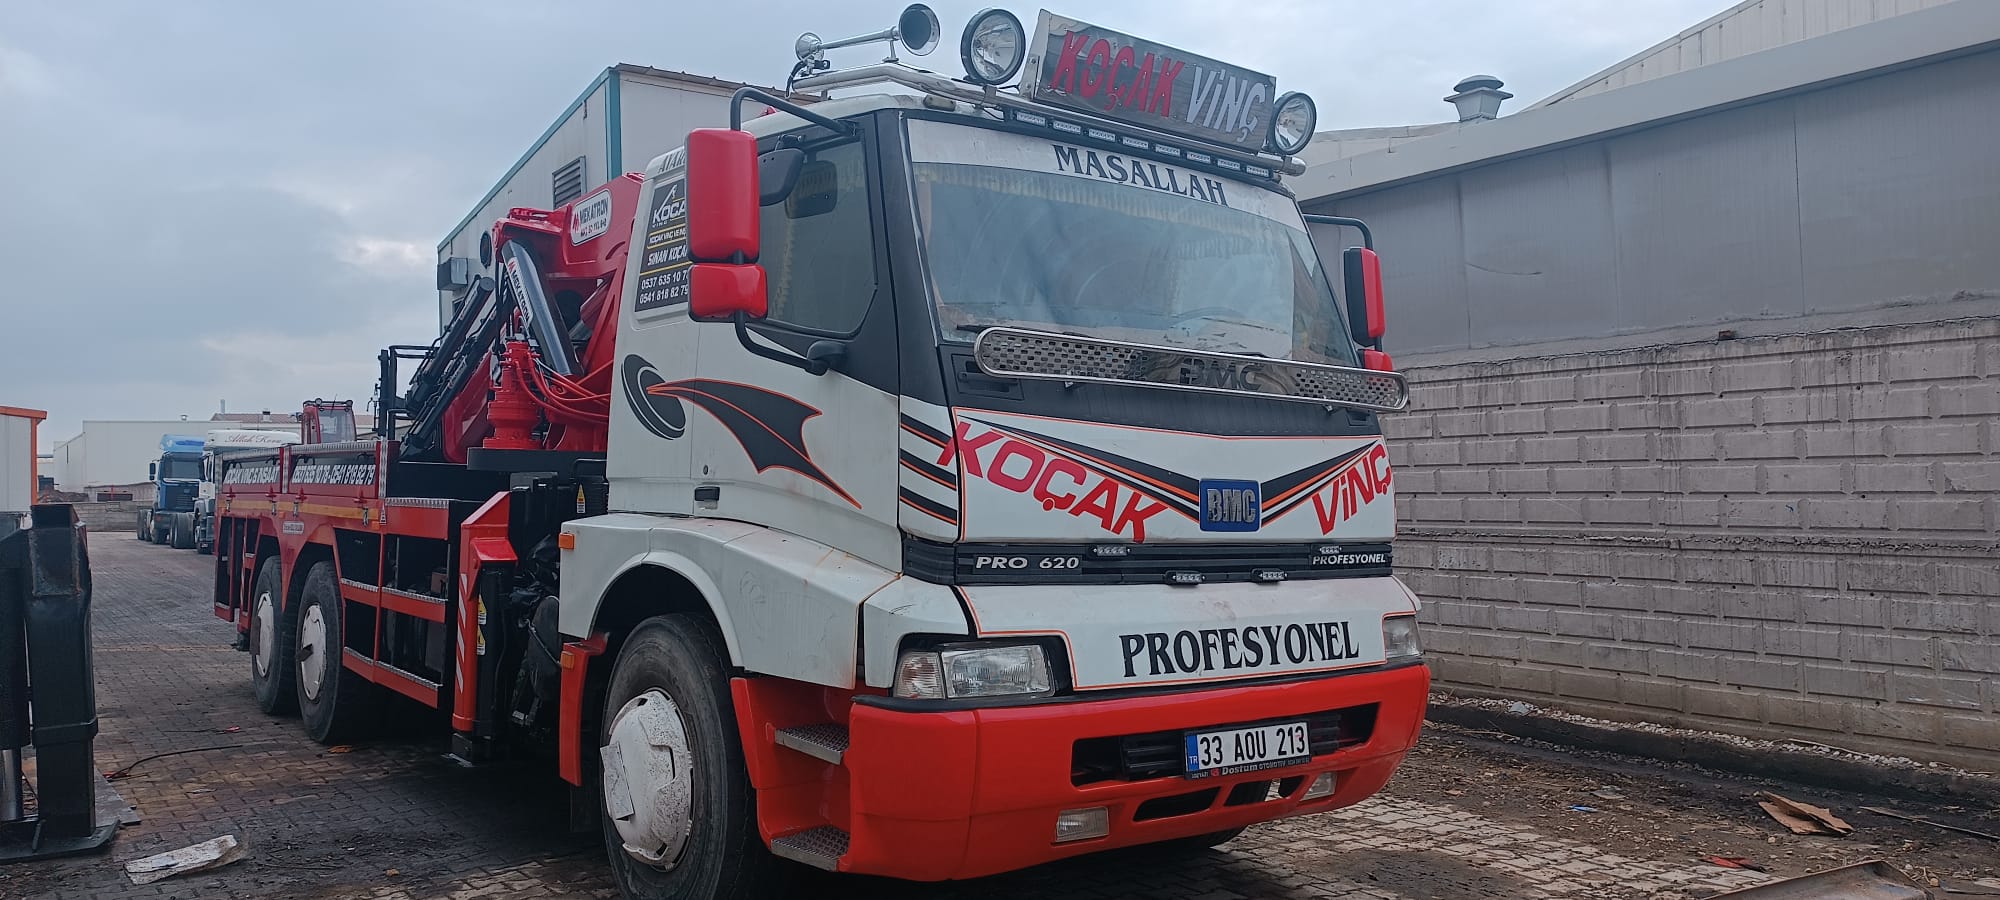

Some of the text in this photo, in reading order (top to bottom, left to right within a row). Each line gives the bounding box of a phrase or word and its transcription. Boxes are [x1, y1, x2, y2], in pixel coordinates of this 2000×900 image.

[1050, 30, 1267, 142] KOÇAK VİNÇ
[641, 277, 657, 290] 0537
[659, 273, 671, 286] 635
[673, 271, 681, 283] 10
[640, 291, 656, 304] 0541
[670, 286, 679, 298] 82
[937, 421, 1168, 543] KOÇAK
[1310, 443, 1392, 536] VİNÇ
[1207, 488, 1257, 523] BMC
[976, 556, 1080, 569] PRO 620
[1312, 553, 1386, 565] PROFESYONEL
[1119, 621, 1360, 678] PROFESYONEL
[1200, 725, 1306, 767] 33 AOU 213
[1189, 755, 1198, 765] TR
[1221, 763, 1258, 776] Dostum
